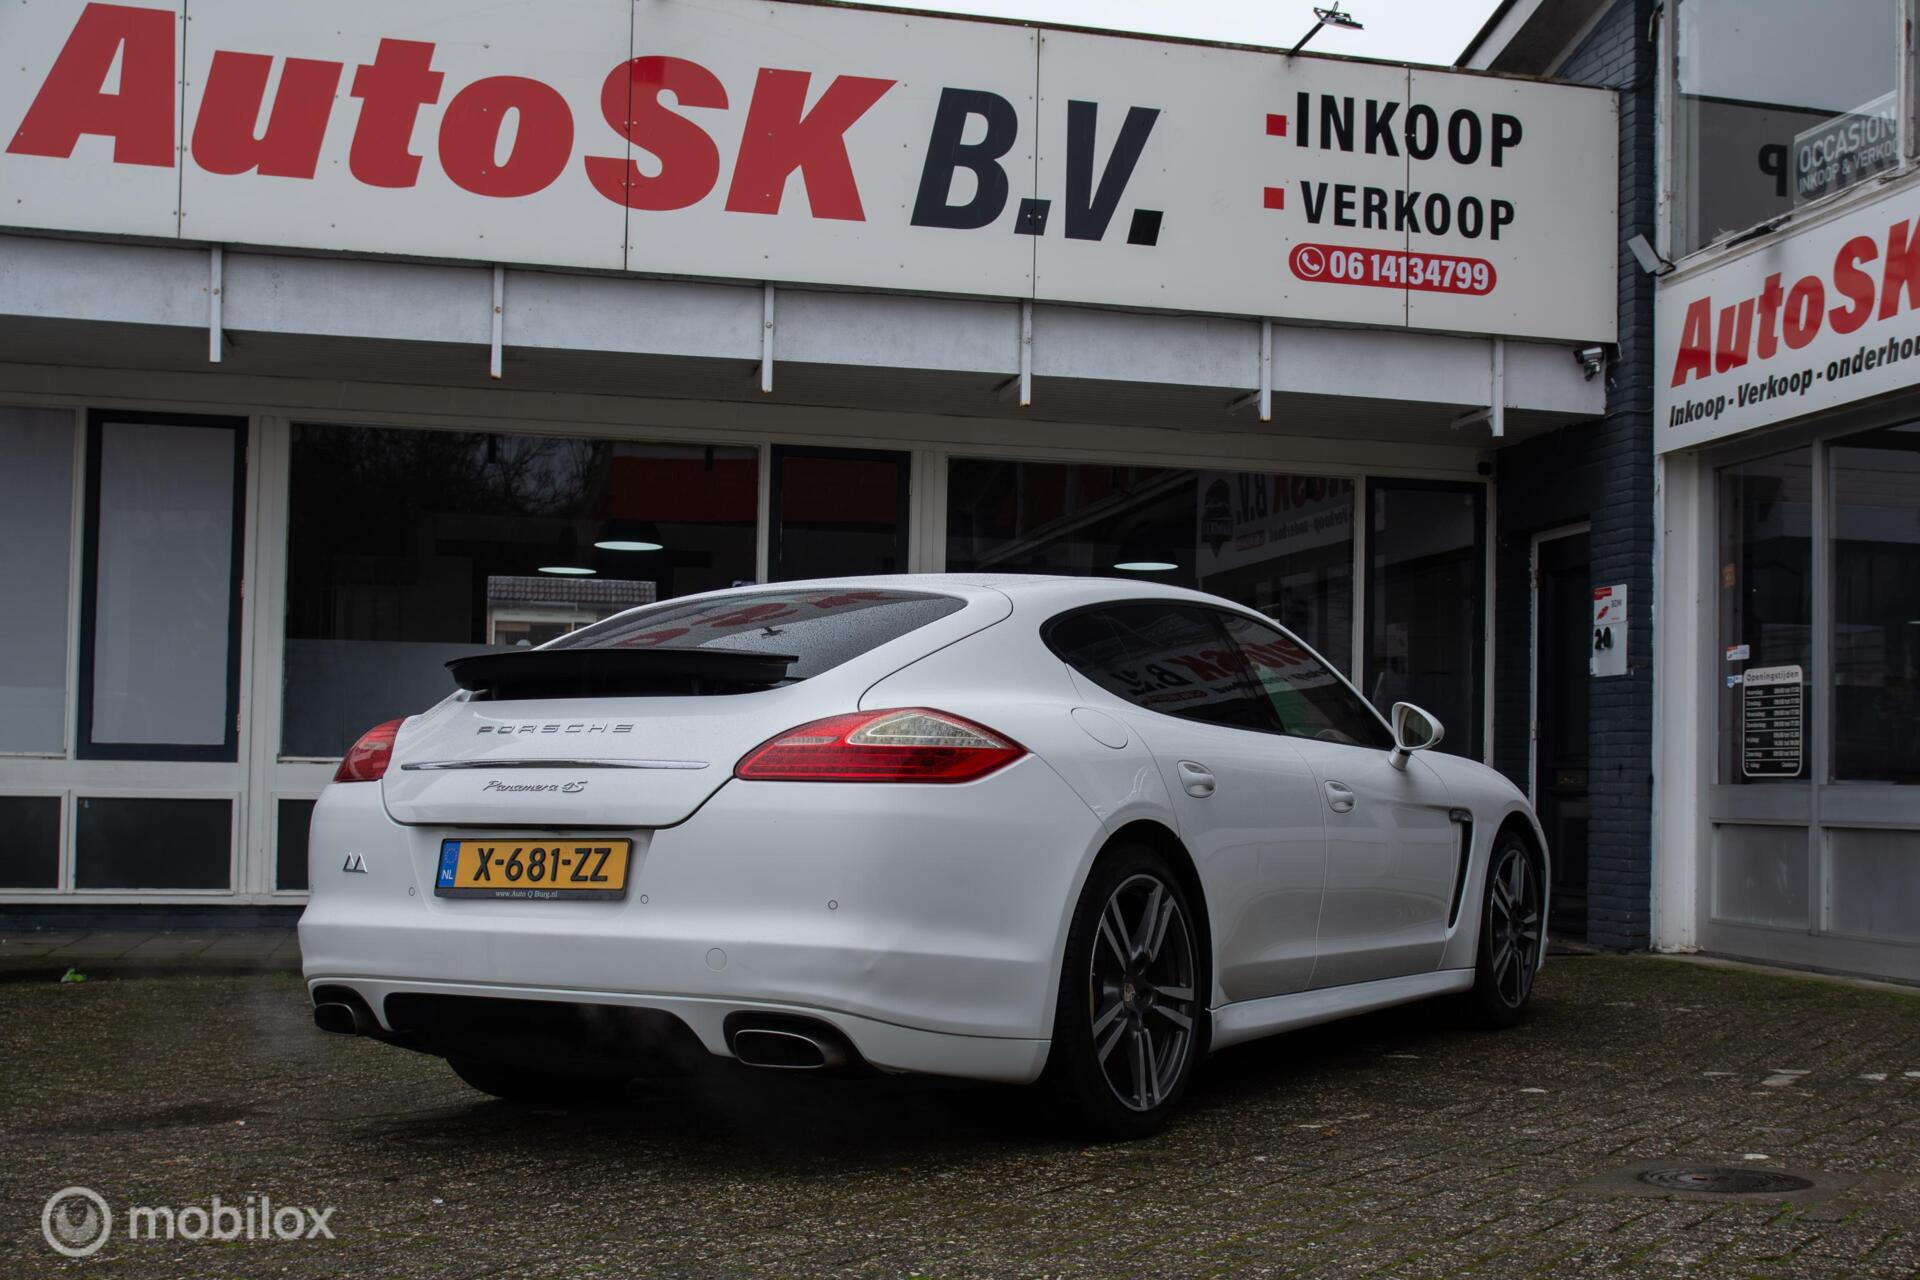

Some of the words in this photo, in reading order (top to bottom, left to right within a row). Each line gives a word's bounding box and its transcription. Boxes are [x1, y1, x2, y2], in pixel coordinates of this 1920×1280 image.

[5, 2, 898, 222] AutoSK
[910, 86, 1164, 246] B.V.
[1296, 91, 1523, 168] INKOOP
[1799, 163, 1839, 194] INKOOP
[1842, 158, 1850, 175] &
[1299, 180, 1515, 241] VERKOOP
[1330, 250, 1364, 280] 06
[1371, 253, 1489, 291] 14134799
[1671, 215, 1920, 389] AutoSK
[1669, 393, 1725, 428] Inkoop
[1737, 370, 1813, 408] Verkoop
[1746, 670, 1800, 683] Openingstijden
[476, 723, 635, 736] PORSCHE
[483, 779, 559, 792] Panamera
[562, 780, 589, 793] 4S
[441, 869, 454, 880] NL
[472, 847, 612, 882] X-681-ZZ
